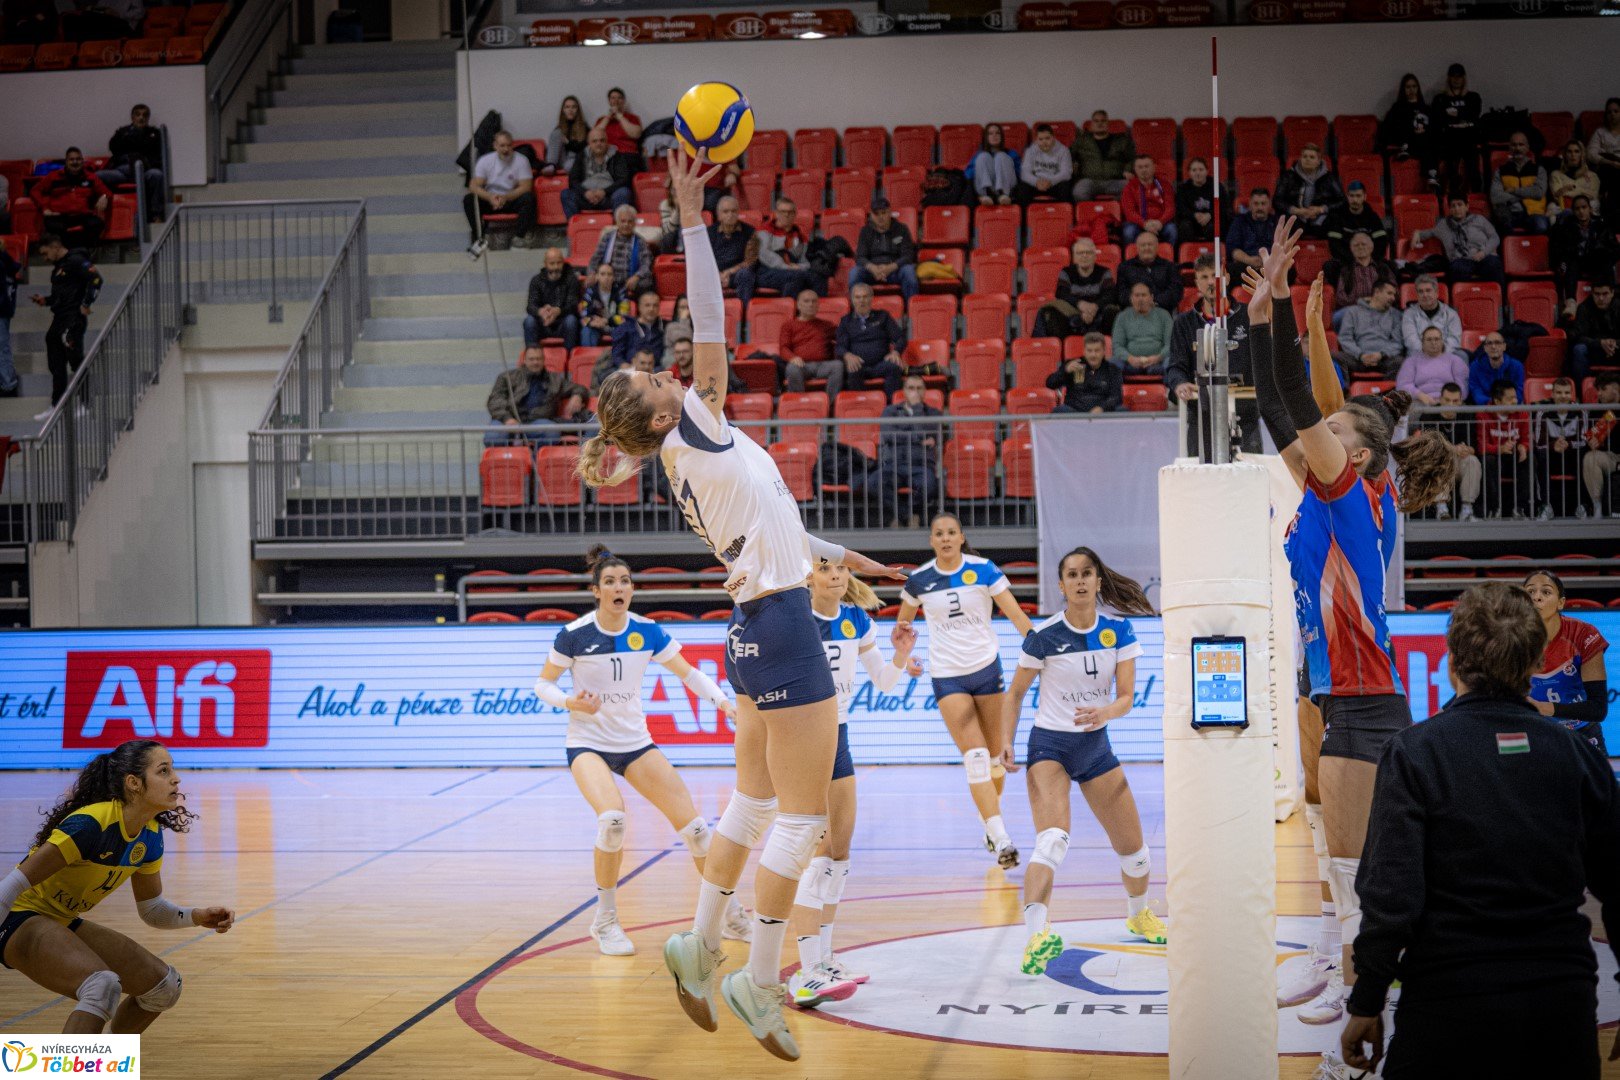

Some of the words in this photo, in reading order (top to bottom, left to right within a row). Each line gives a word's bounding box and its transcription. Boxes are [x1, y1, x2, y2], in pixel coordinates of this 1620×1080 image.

[947, 592, 961, 613] 3
[611, 657, 623, 681] 11
[1084, 655, 1099, 680] 4
[80, 660, 237, 738] Alfi
[298, 683, 364, 718] Ahol
[370, 700, 388, 715] a
[394, 690, 464, 726] pénze
[1547, 688, 1561, 703] 6
